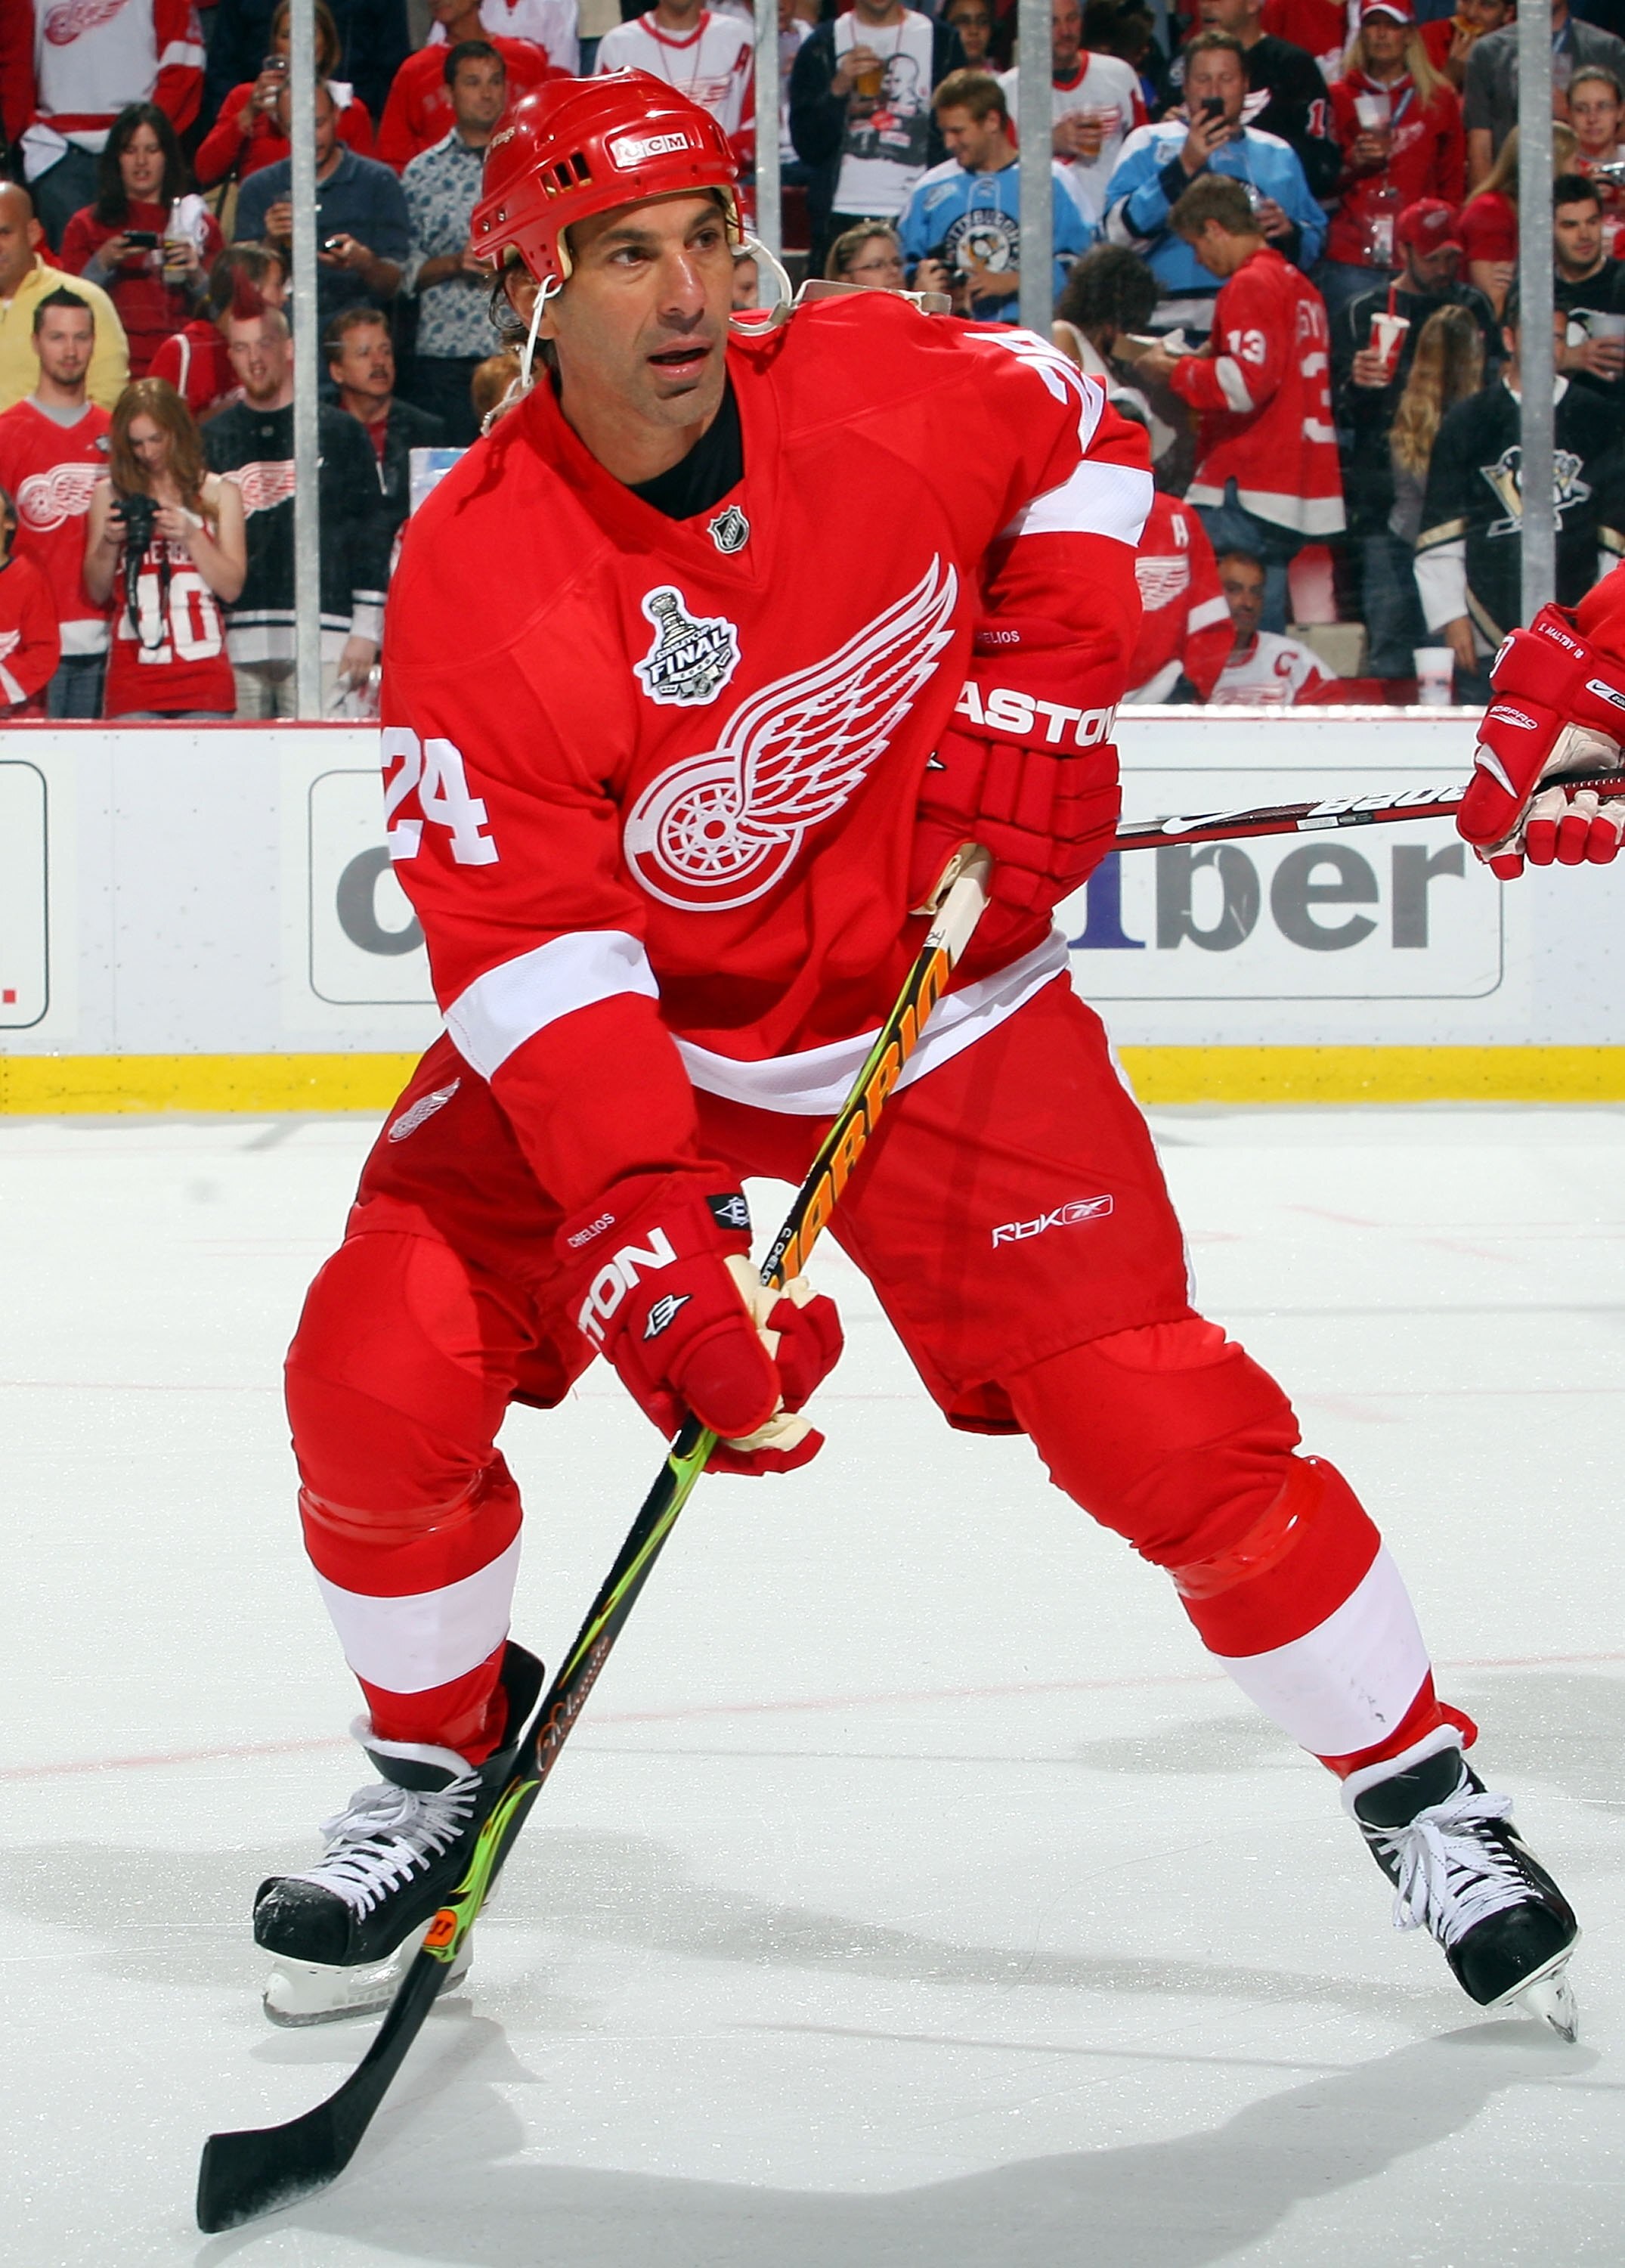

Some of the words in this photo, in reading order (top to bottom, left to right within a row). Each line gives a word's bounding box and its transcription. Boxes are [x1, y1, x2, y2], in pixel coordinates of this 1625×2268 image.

[624, 135, 684, 159] CCM
[1227, 329, 1266, 365] 13
[649, 627, 729, 685] FINAL
[1274, 651, 1300, 677] C
[380, 726, 500, 866] 24
[567, 1213, 616, 1247] CHELIOS
